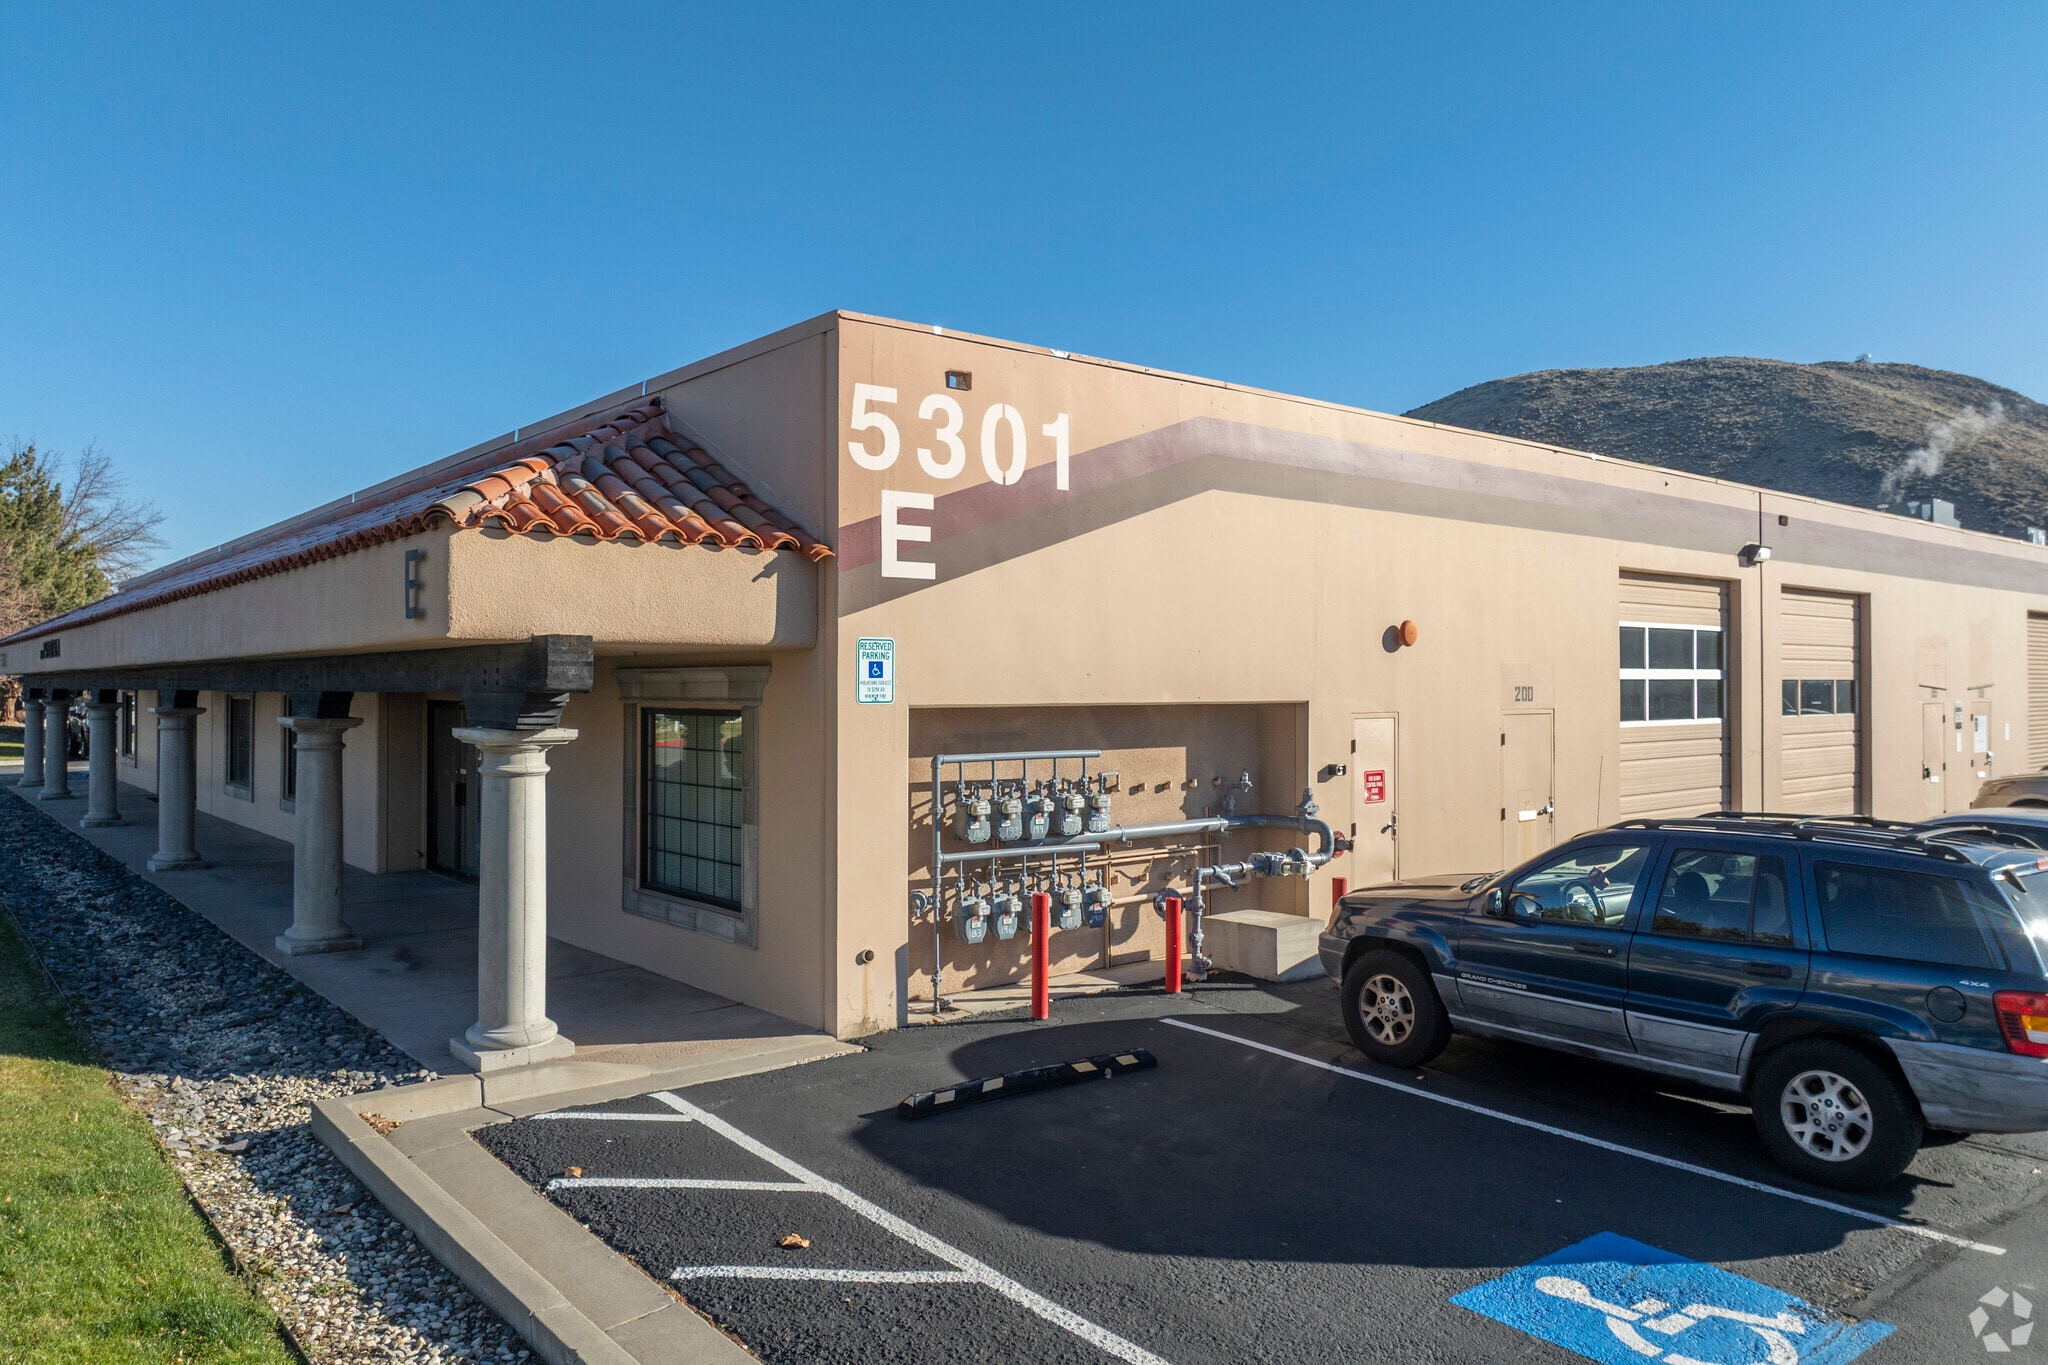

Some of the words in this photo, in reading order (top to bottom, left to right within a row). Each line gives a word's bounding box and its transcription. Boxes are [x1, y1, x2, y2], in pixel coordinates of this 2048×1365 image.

[848, 382, 1070, 491] 5301
[881, 489, 936, 580] E
[860, 641, 892, 651] RESERVED
[861, 651, 890, 660] PARKING
[1514, 686, 1533, 702] 200
[1093, 821, 1108, 832] 198
[1001, 926, 1014, 934] 196
[1461, 972, 1487, 982] GRAND
[1487, 978, 1528, 990] CHEROKEE
